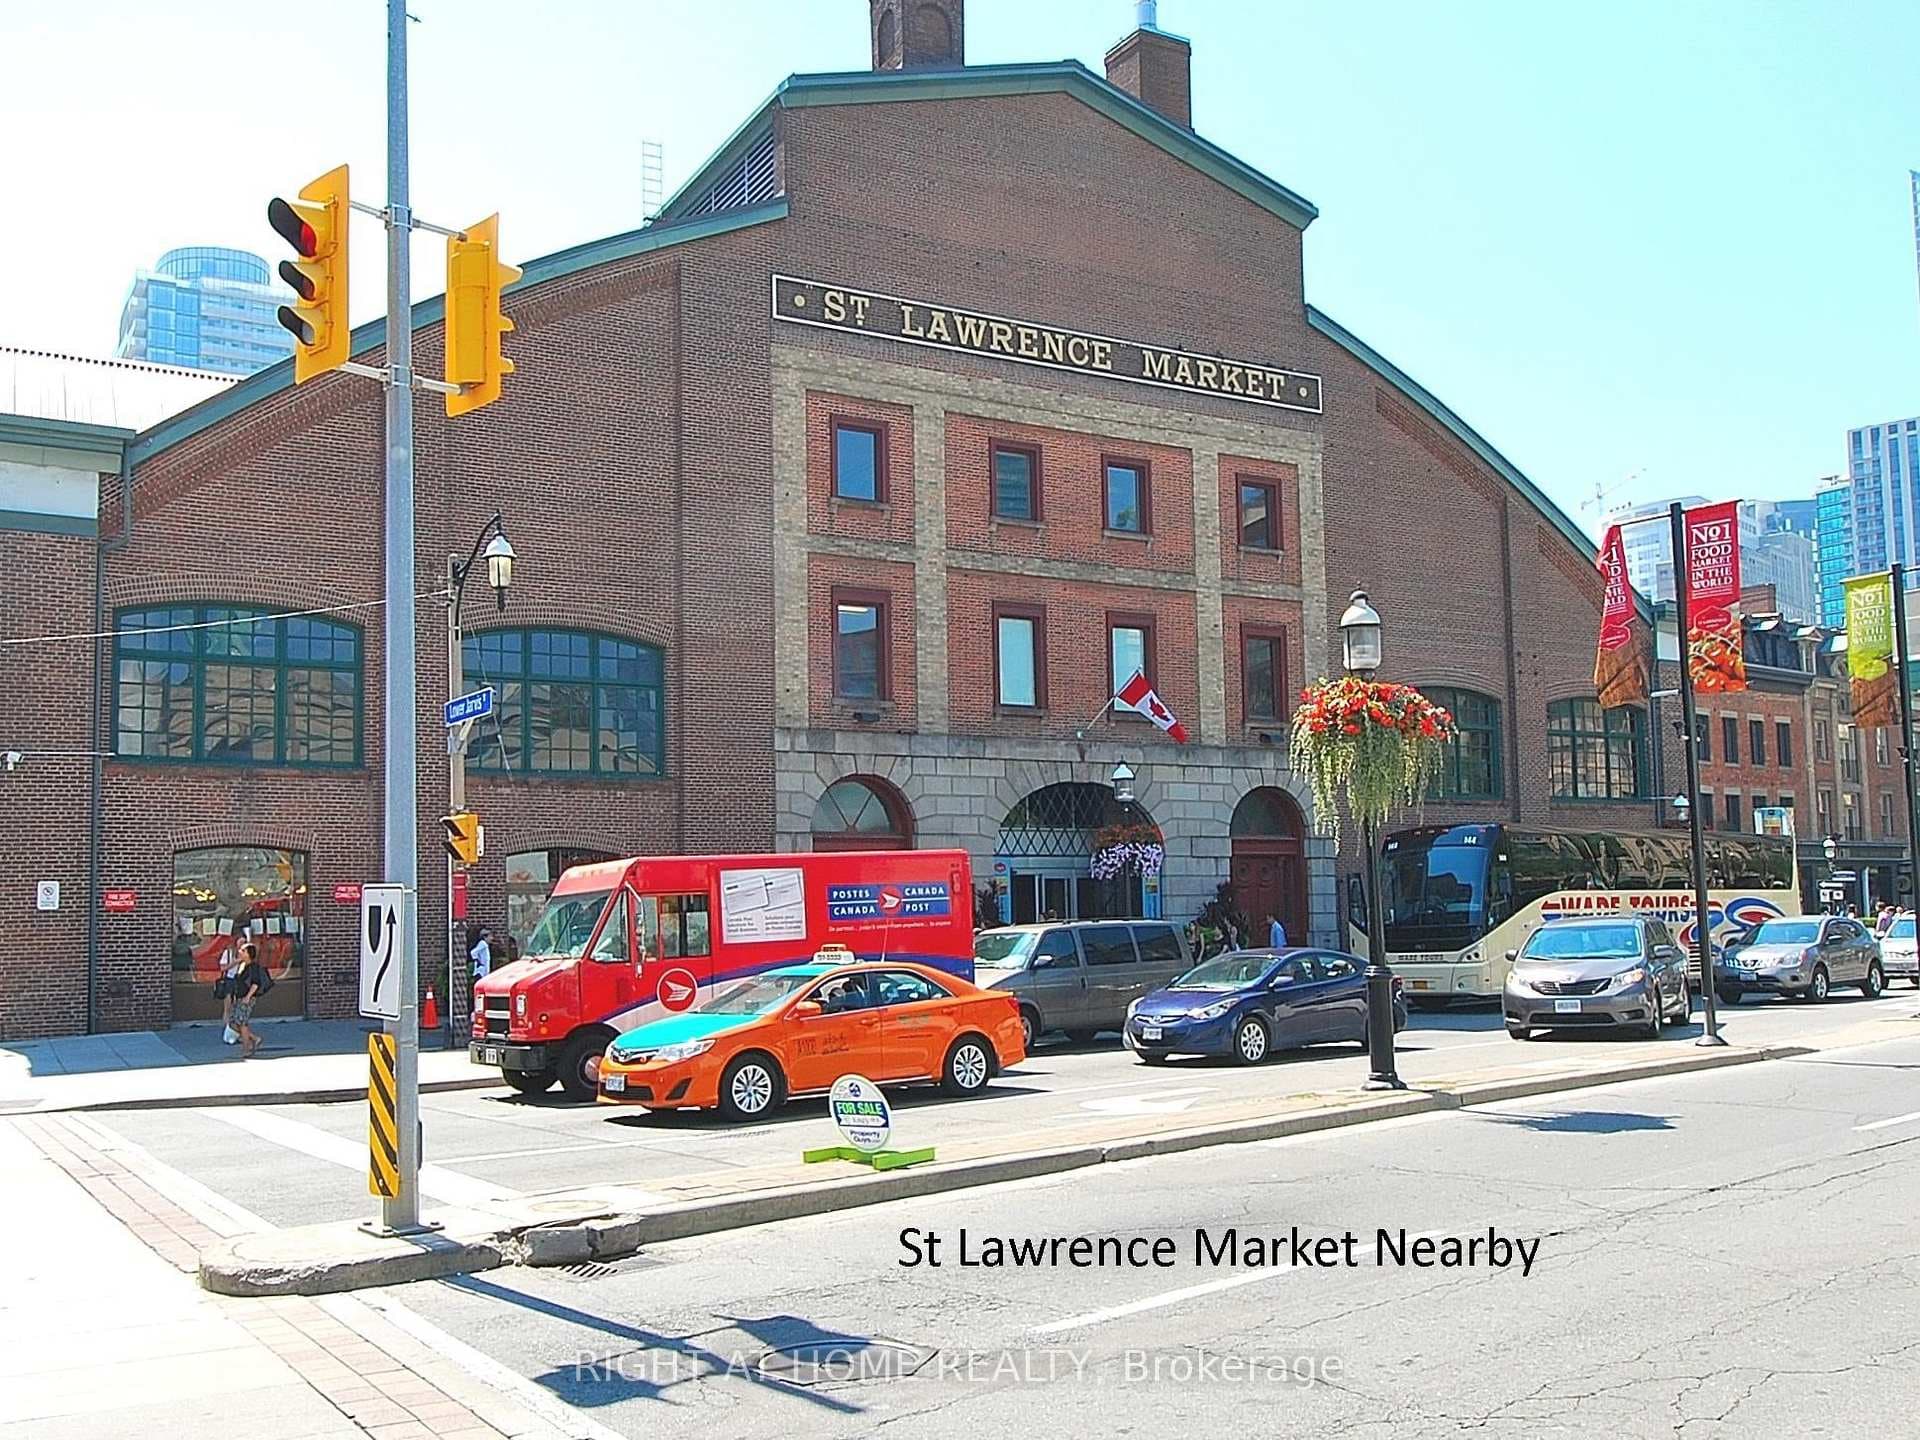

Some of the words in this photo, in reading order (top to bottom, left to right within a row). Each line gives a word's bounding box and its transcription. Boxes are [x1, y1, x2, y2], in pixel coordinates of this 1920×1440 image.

[901, 305, 1112, 370] LAWRENCE
[1142, 350, 1286, 399] MARKET
[1691, 544, 1732, 560] FOOD
[1692, 556, 1731, 569] MARKET
[1692, 570, 1704, 581] IN
[1707, 566, 1732, 578] THE
[1692, 576, 1733, 589] WORLD
[832, 889, 870, 899] POSTES
[904, 887, 945, 896] CANADA
[833, 905, 876, 915] CANADA
[905, 903, 929, 912] POST
[835, 1101, 856, 1114] FOR
[857, 1102, 884, 1116] SALE
